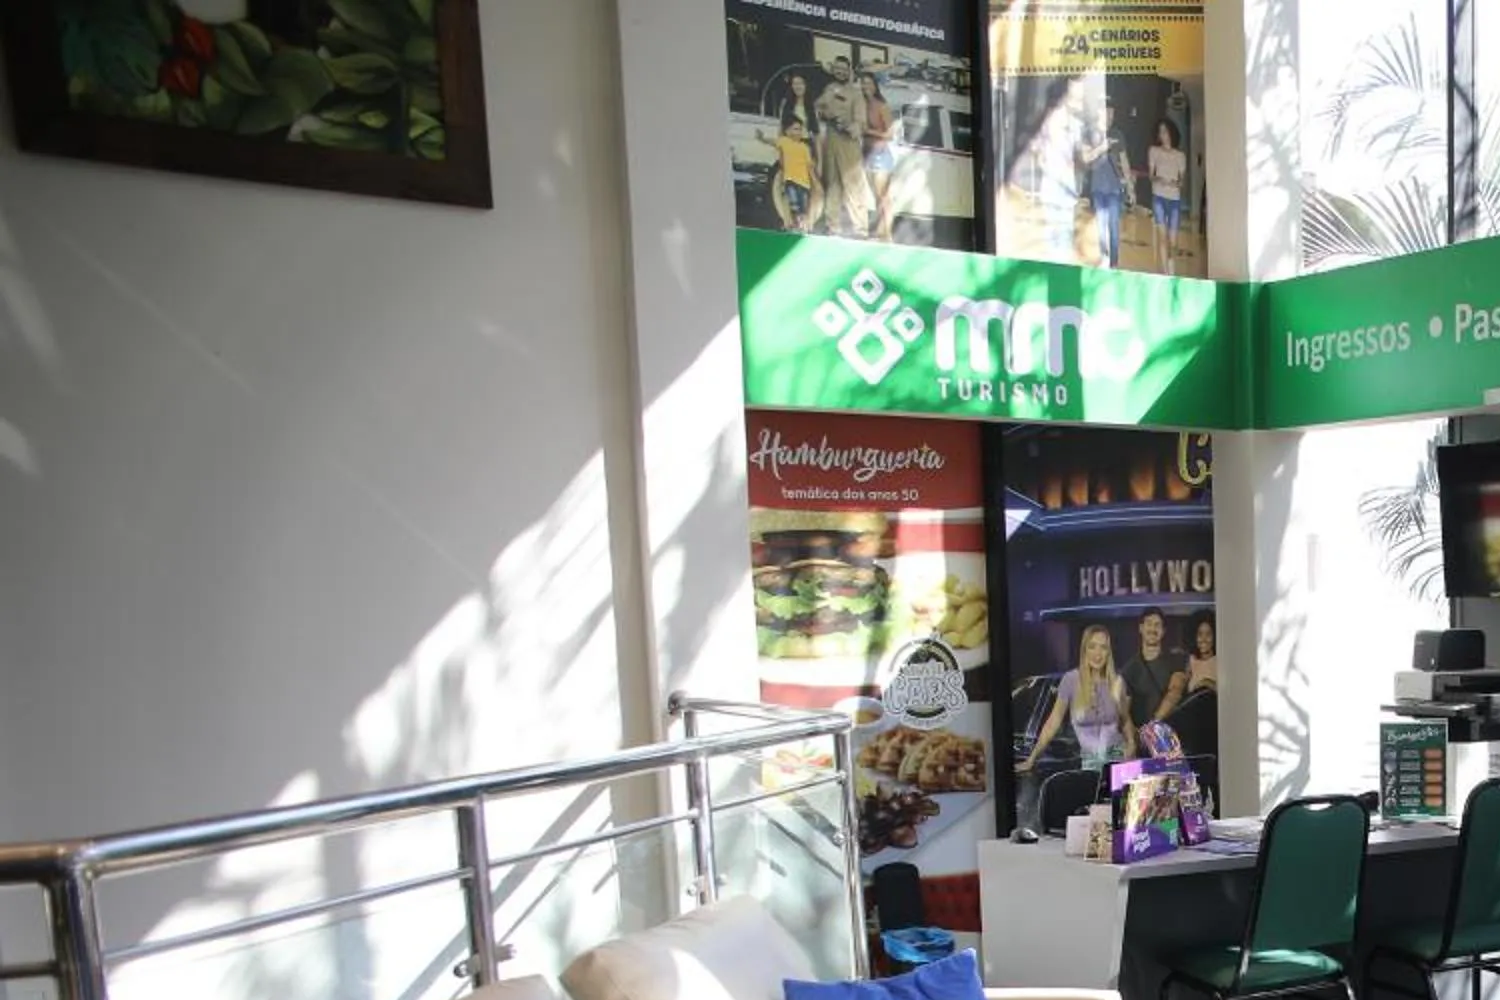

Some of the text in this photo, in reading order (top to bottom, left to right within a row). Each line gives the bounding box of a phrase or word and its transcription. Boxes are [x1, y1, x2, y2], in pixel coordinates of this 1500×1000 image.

[1286, 319, 1411, 373] Ingressos
[937, 378, 1067, 406] TURISMO
[750, 428, 945, 483] Hamburgueria
[781, 486, 919, 502] temática dos anos 50
